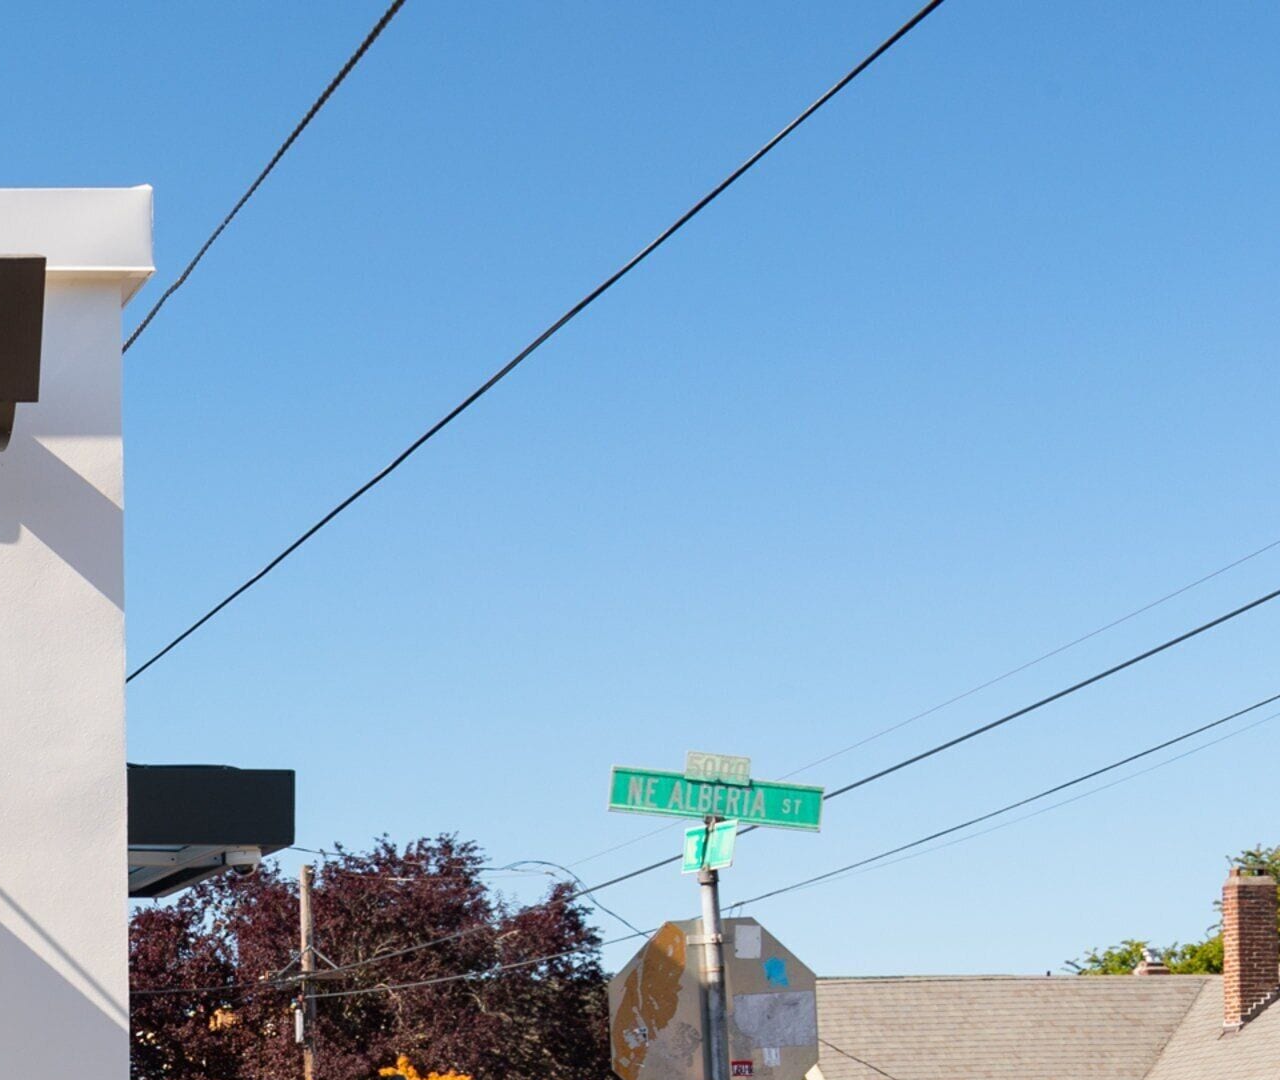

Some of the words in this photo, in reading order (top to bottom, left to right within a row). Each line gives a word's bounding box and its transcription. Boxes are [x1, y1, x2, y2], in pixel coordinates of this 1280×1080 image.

[627, 775, 660, 808] NE
[666, 780, 766, 818] ALBERTA
[781, 798, 802, 815] ST
